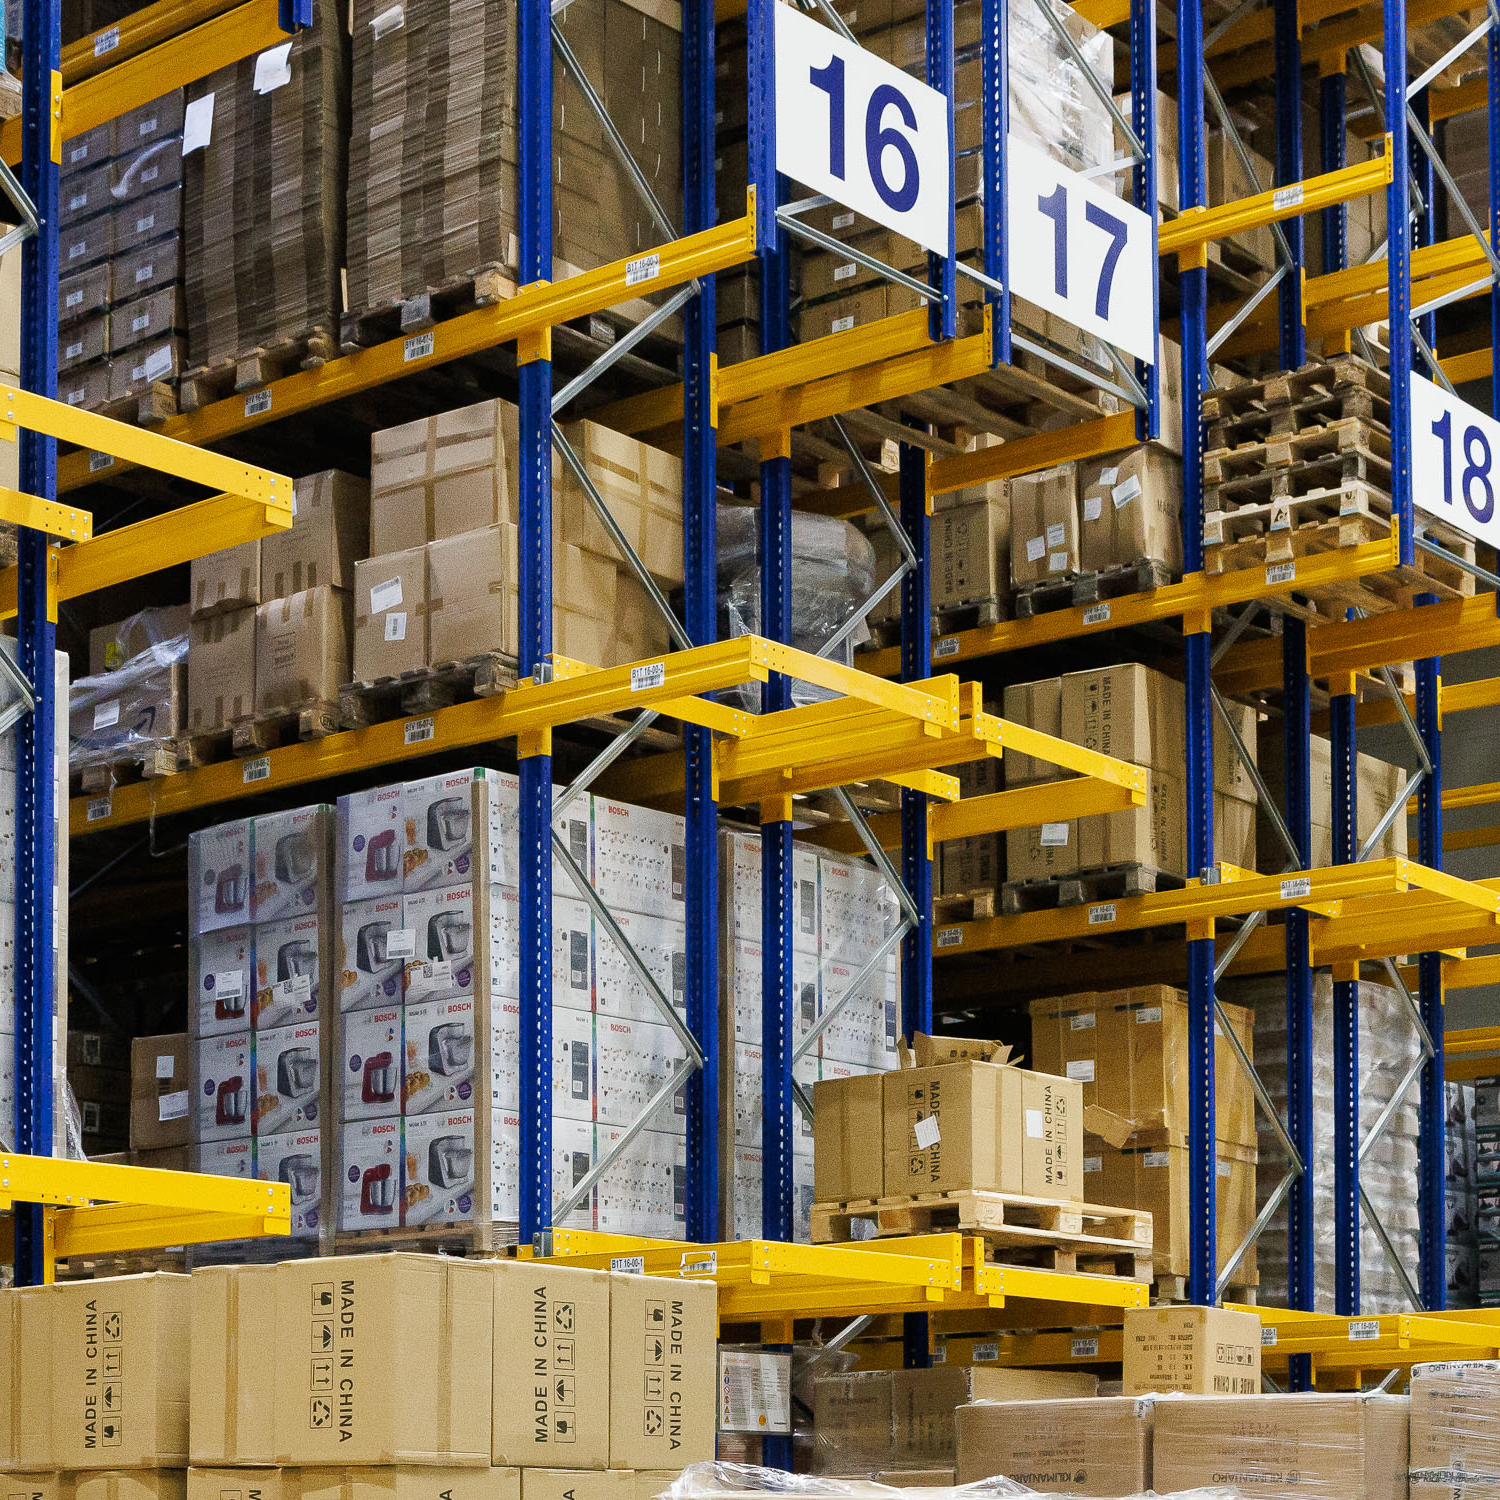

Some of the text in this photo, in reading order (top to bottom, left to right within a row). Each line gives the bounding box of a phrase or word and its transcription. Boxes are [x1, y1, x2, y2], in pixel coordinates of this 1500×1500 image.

[810, 54, 920, 213] 16
[1038, 183, 1128, 321] 17
[626, 261, 638, 273] B1T
[1431, 409, 1495, 524] 18
[944, 516, 953, 595] MADE IN CHINA
[631, 662, 665, 679] B1T 16-00-2
[445, 776, 469, 788] BOSCH
[377, 790, 400, 801] BOSCH
[607, 806, 629, 817] BOSCH
[831, 868, 849, 877] BOSCH
[446, 890, 471, 900] BOSCH
[374, 902, 399, 912] BOSCH
[294, 921, 317, 931] BOSCH
[831, 967, 850, 976] BOSCH
[447, 1003, 472, 1013] BOSCH
[373, 1012, 397, 1022] BOSCH
[294, 1028, 317, 1038] BOSCH
[610, 1024, 632, 1034] BOSCH
[225, 1038, 247, 1048] BOSCH
[833, 1067, 851, 1075] BOSCH
[447, 1116, 472, 1125] BOSCH
[372, 1125, 396, 1133] BOSCH
[930, 1081, 940, 1183] MADE CHINA
[1044, 1085, 1053, 1185] MADE IN CHINA
[296, 1136, 319, 1146] BOSCH
[611, 1257, 645, 1271] B1T 16-00-1
[340, 1281, 355, 1443] MADE IN CHINA
[534, 1287, 547, 1443] MADE IN CHINA
[85, 1300, 97, 1449] MADE IN CHINA
[670, 1301, 683, 1450] MADE IN CHINA
[1212, 1473, 1283, 1483] KILIMANJARO
